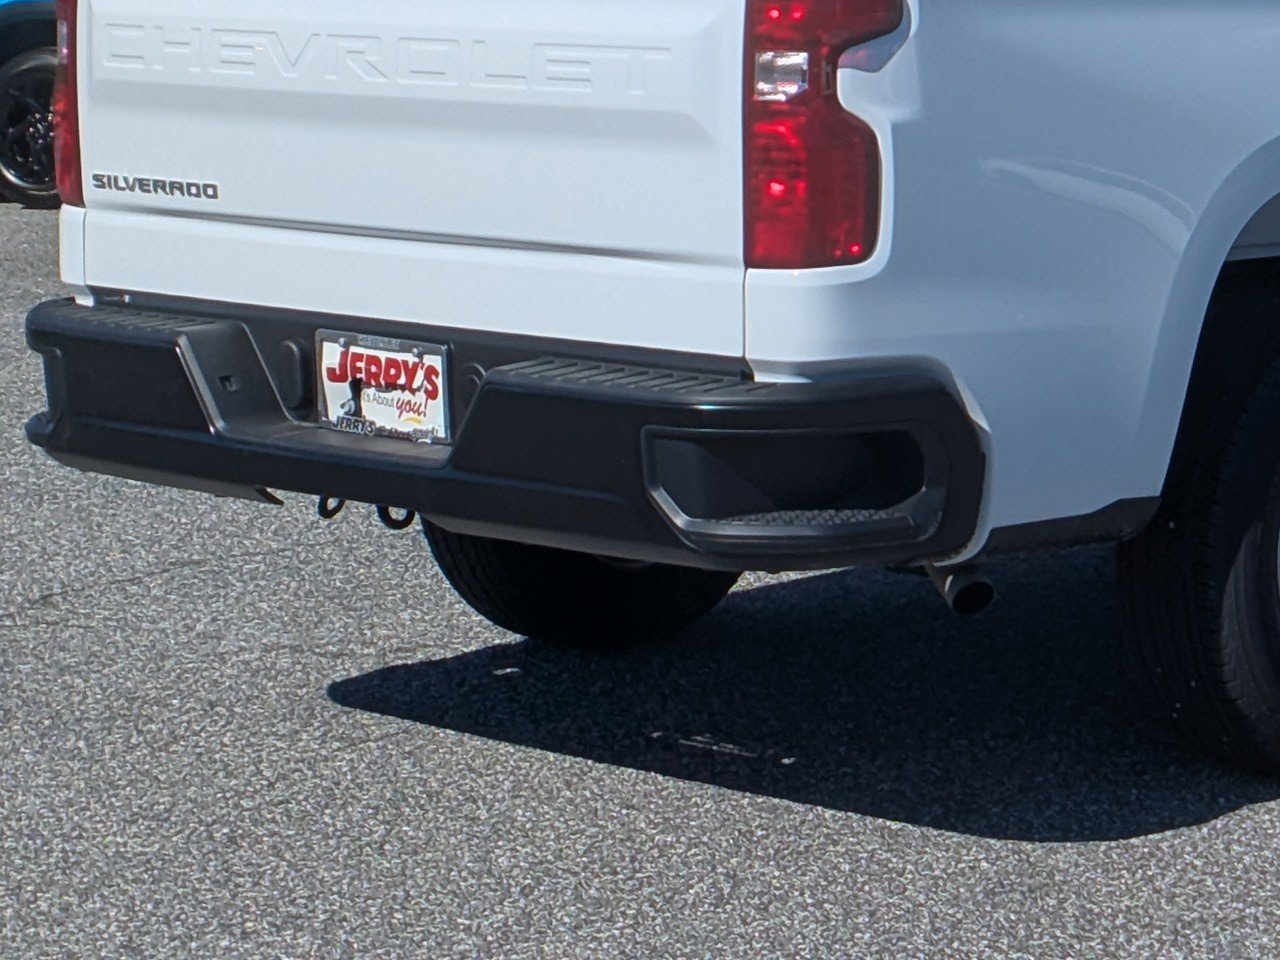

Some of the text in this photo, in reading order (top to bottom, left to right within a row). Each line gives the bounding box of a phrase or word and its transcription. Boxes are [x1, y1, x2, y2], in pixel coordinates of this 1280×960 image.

[103, 23, 672, 95] CHEVROLET
[92, 173, 219, 200] SILVERADO
[326, 348, 440, 401] JERRY'S
